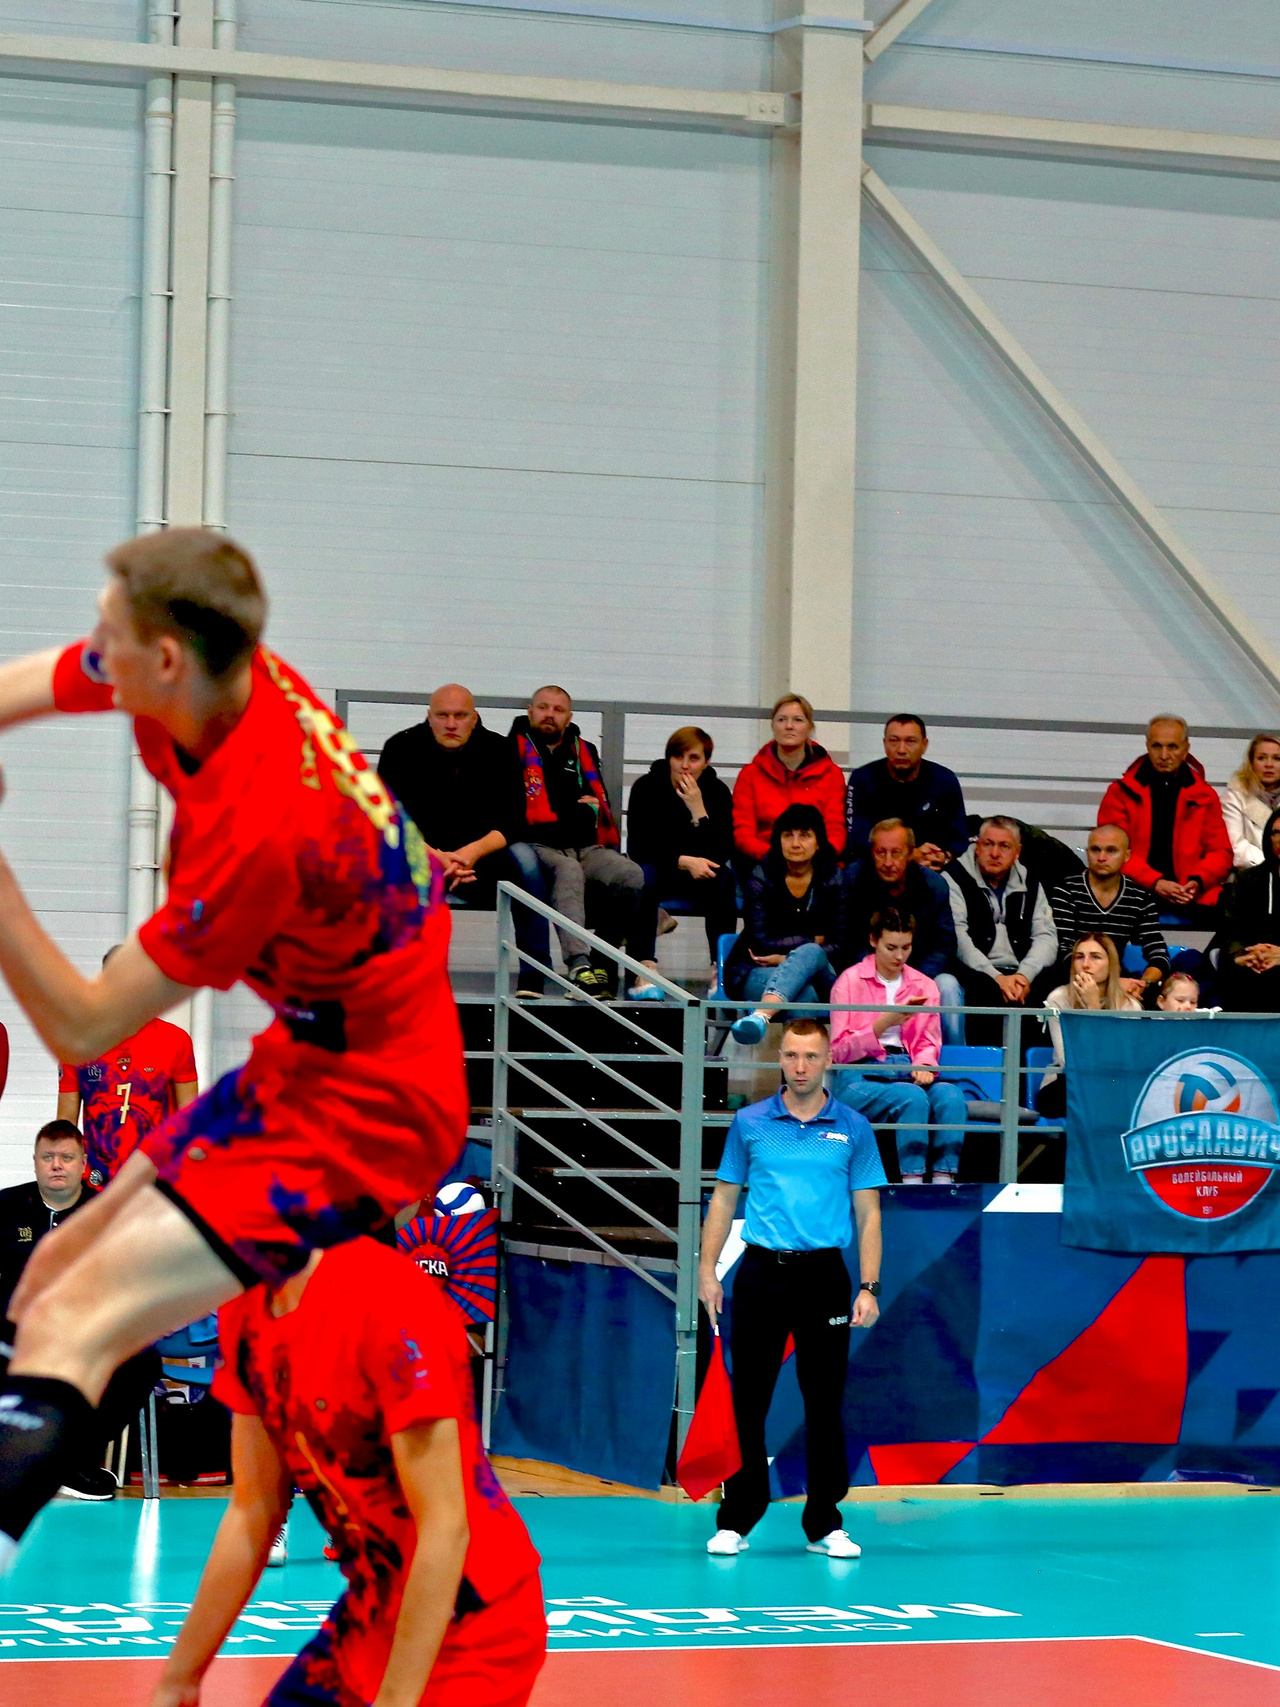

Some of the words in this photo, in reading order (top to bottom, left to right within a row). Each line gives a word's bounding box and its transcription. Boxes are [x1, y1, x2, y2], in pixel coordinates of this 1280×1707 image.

[116, 1083, 131, 1124] 7
[1196, 1186, 1219, 1197] КЛУБ
[415, 1259, 449, 1277] СКА
